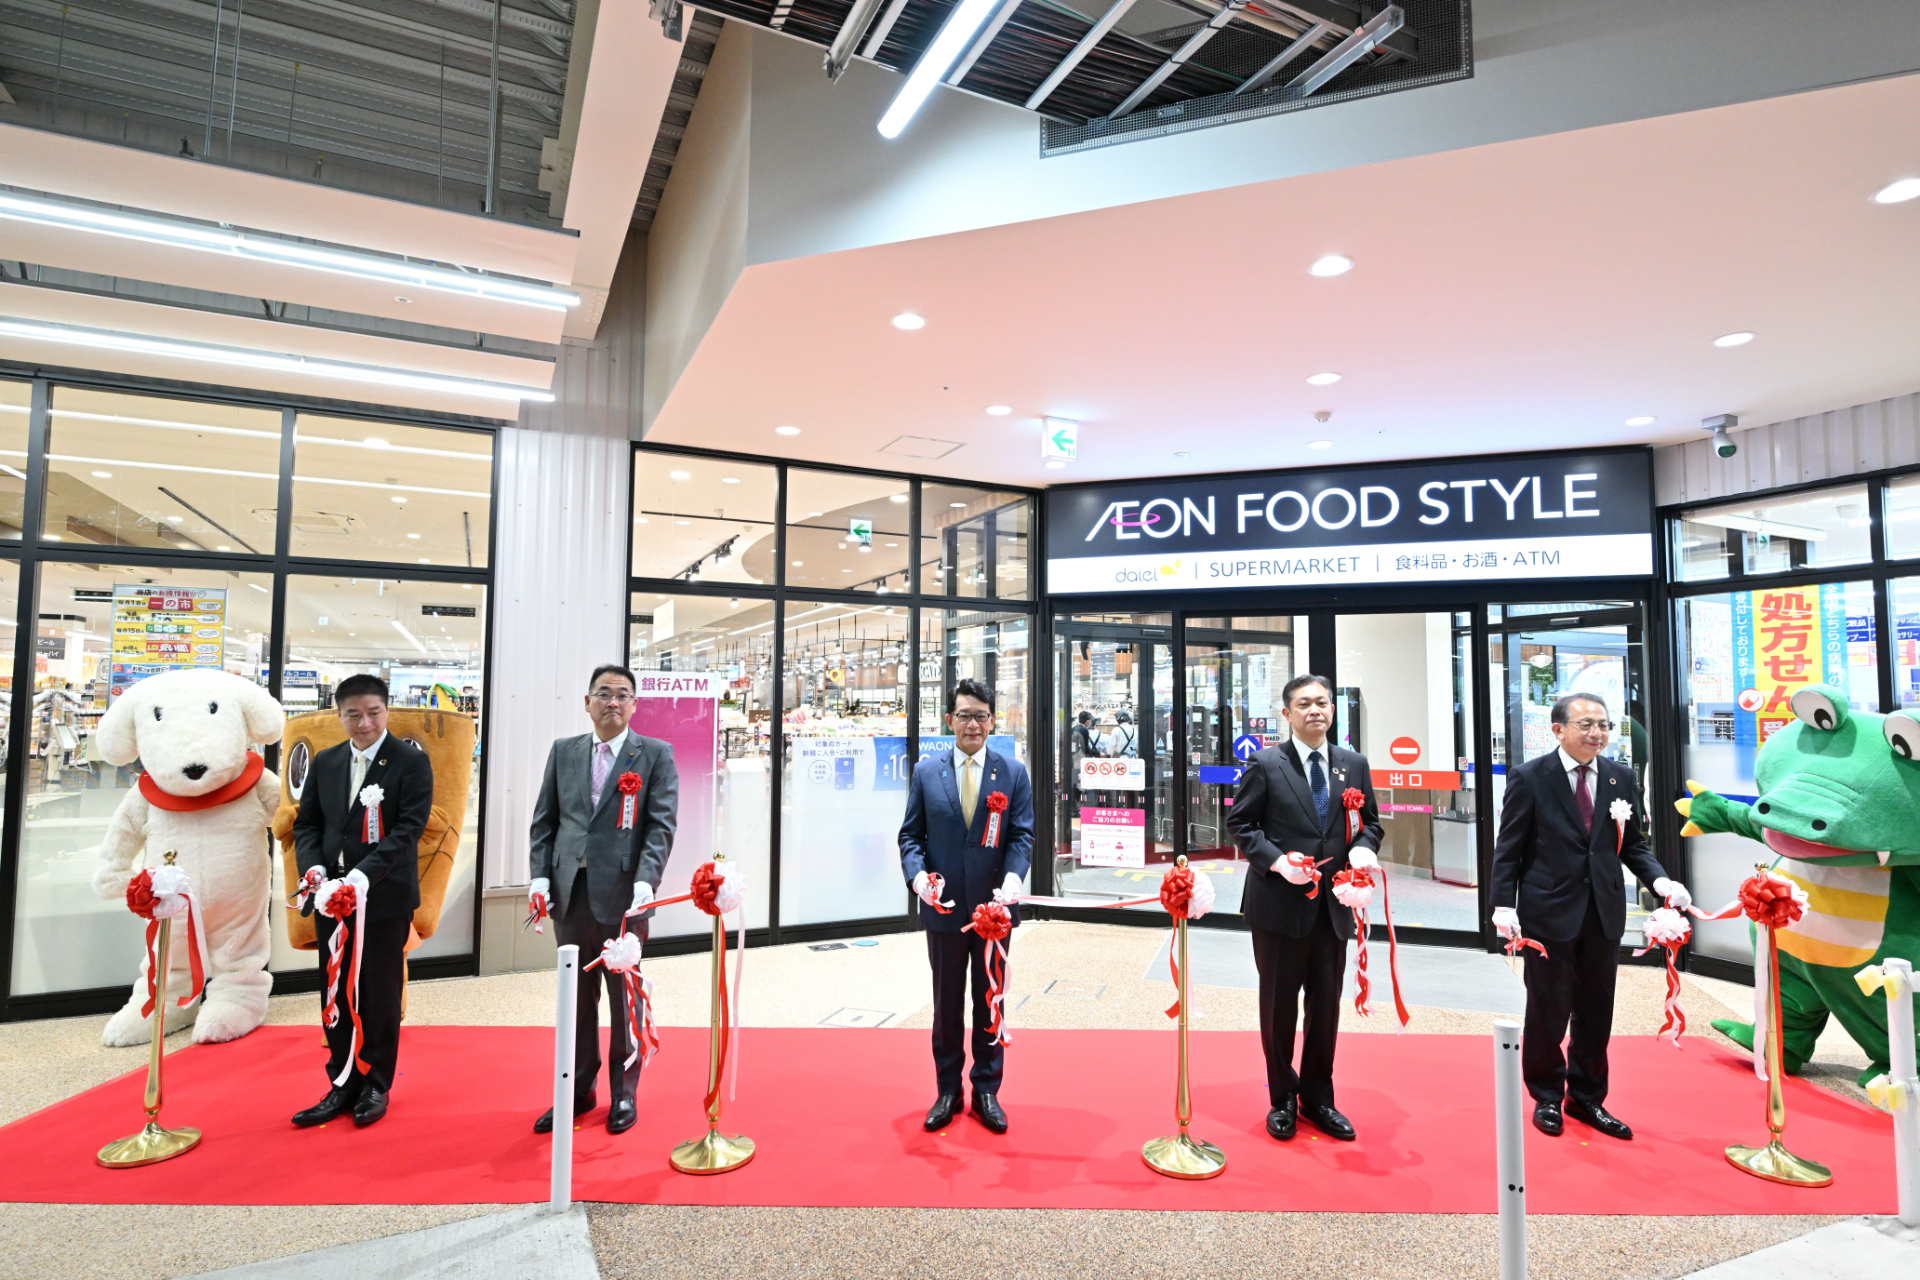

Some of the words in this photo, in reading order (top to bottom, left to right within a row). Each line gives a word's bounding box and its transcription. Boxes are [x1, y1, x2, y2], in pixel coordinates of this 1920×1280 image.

[1237, 486, 1400, 534] FOOD
[1418, 473, 1600, 526] STYLE
[1210, 556, 1361, 578] SUPERMARKET
[1395, 550, 1560, 571] 食料品・お酒・ATM
[150, 600, 192, 610] 一の市
[641, 677, 709, 692] 銀行ATM
[918, 741, 952, 751] WAON
